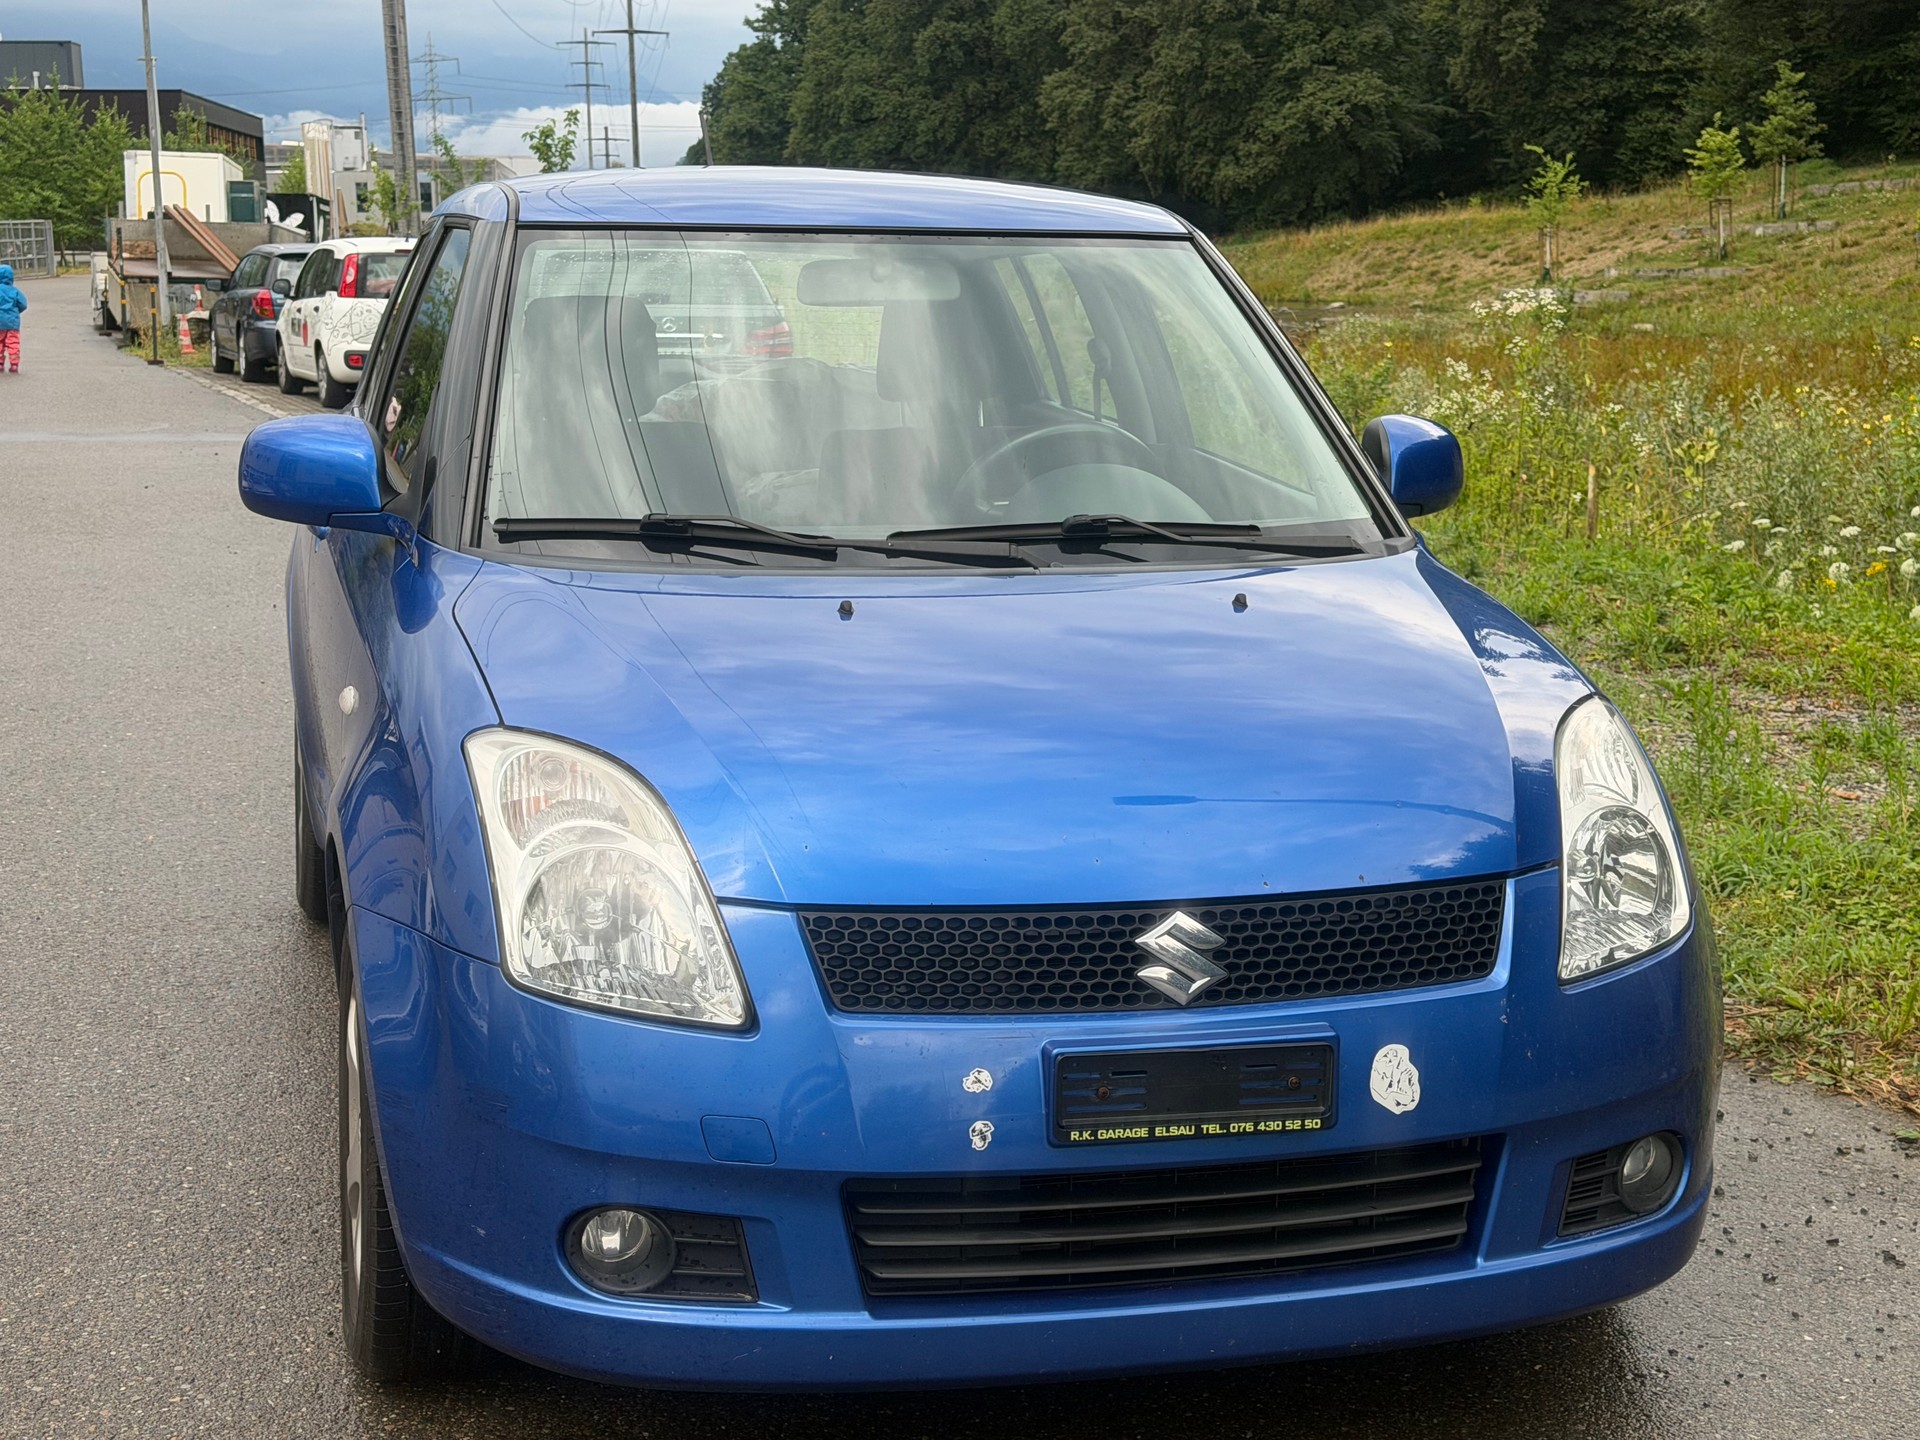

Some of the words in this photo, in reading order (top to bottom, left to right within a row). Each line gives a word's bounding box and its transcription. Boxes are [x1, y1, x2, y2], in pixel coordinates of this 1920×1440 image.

[1070, 1131, 1095, 1141] R.K.
[1097, 1128, 1149, 1140] GARAGE
[1155, 1125, 1195, 1137] ELSAU
[1201, 1124, 1227, 1134] TEL.
[1229, 1122, 1254, 1133] 076
[1257, 1121, 1282, 1131] 430
[1285, 1120, 1301, 1130] 52
[1304, 1119, 1321, 1129] 50
